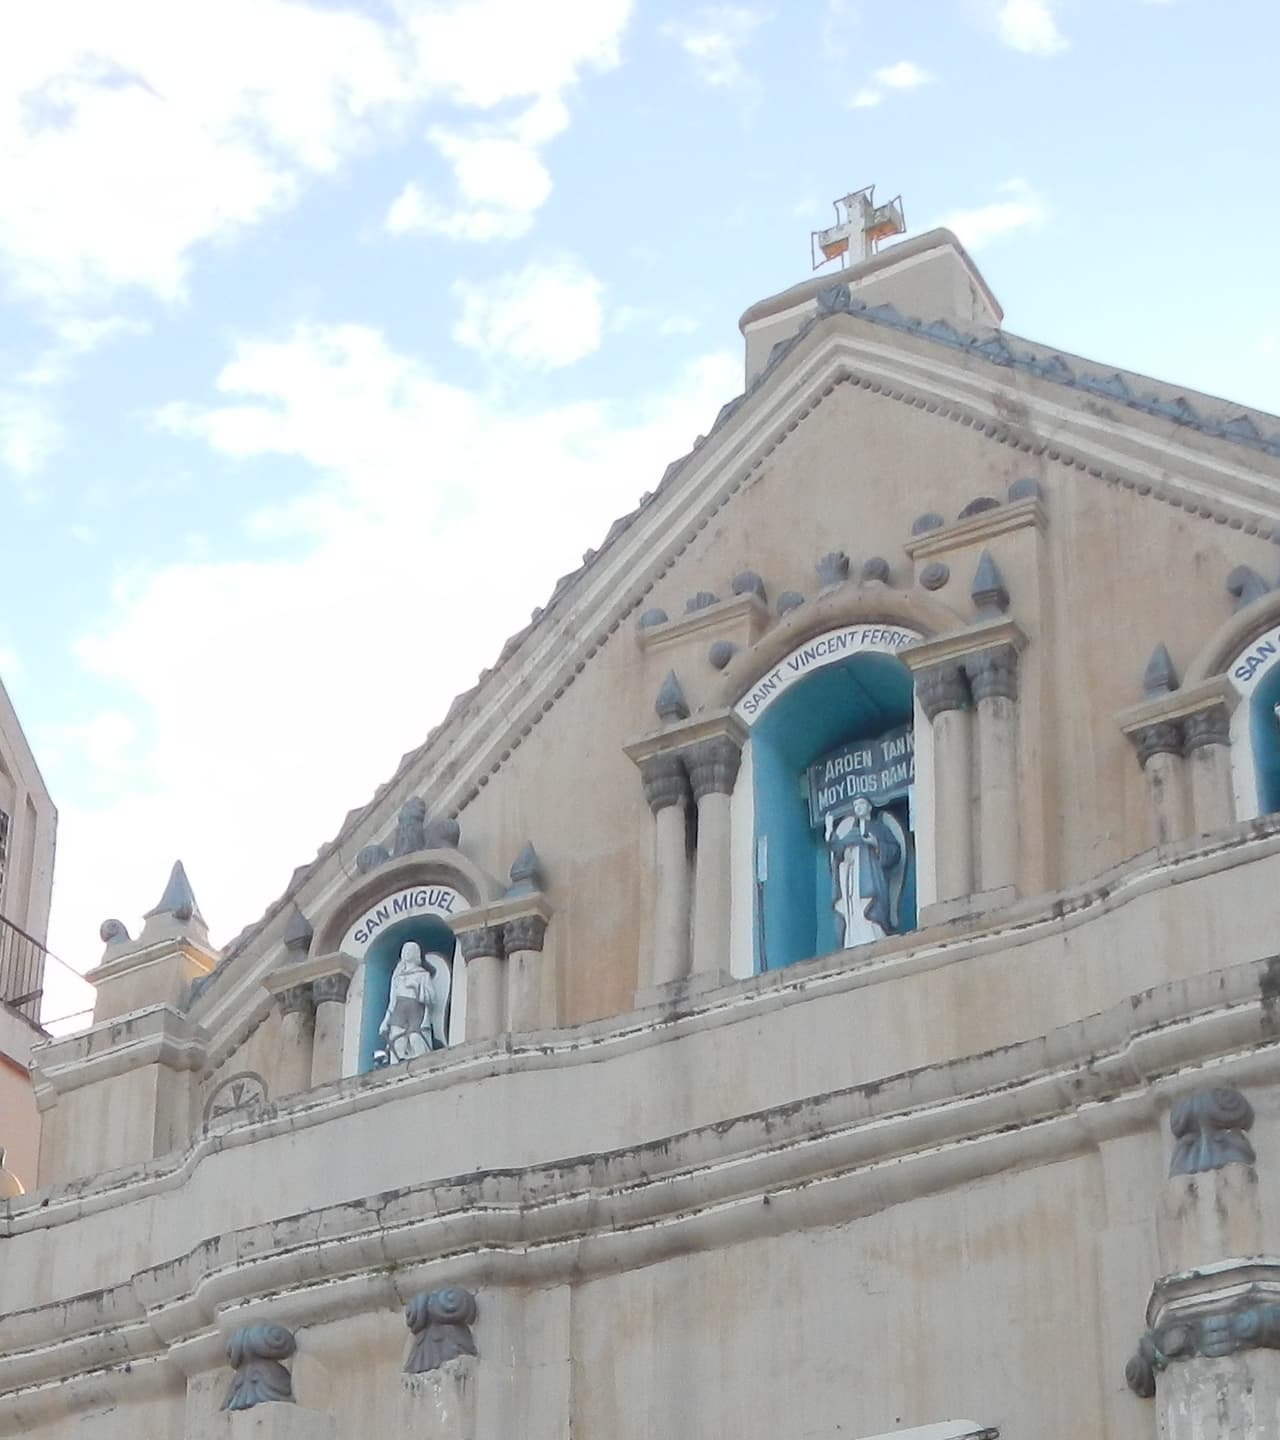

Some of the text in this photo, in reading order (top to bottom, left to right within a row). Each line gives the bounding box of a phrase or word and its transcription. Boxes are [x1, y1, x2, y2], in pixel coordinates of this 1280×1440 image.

[743, 670, 784, 714] SAINT
[787, 630, 857, 672] VINCENT
[1234, 641, 1277, 682] SAN
[354, 889, 456, 945] SAN MIGUEL
